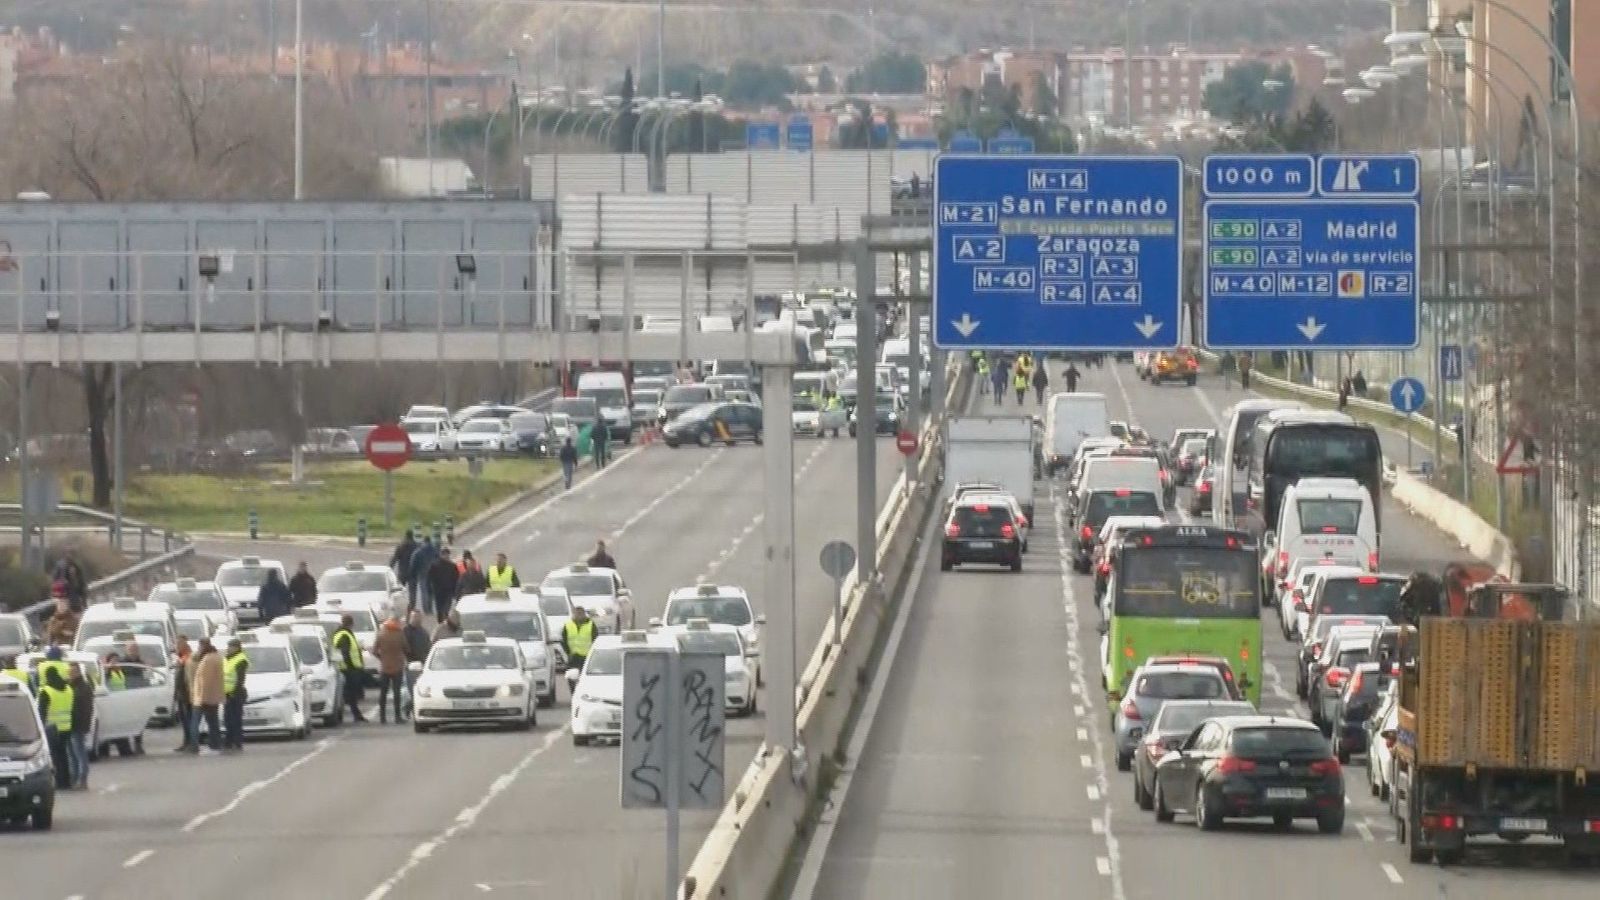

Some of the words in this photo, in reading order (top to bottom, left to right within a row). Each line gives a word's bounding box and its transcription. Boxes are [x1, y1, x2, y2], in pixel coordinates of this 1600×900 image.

[1031, 172, 1084, 189] M-14
[1215, 167, 1274, 185] 1000
[1285, 170, 1301, 184] m
[1393, 168, 1401, 185] 1
[1001, 195, 1046, 215] San
[1056, 195, 1168, 215] Fernando
[942, 206, 995, 222] M-21
[1212, 223, 1255, 237] E-90
[1265, 223, 1298, 237] A-2
[1326, 220, 1397, 240] Madrid
[957, 240, 1001, 258] A-2
[1037, 235, 1140, 256] Zaragoza
[1044, 257, 1080, 274] R-3
[1095, 257, 1135, 274] A-3
[1212, 250, 1255, 263] E-90
[1265, 250, 1298, 263] A-2
[1331, 250, 1349, 264] de
[1353, 250, 1413, 264] servicio
[976, 271, 1032, 287] M-40
[1213, 276, 1272, 292] M-40
[1281, 276, 1329, 292] M-12
[1374, 276, 1408, 292] R-2
[1043, 284, 1083, 301] R-4
[1097, 284, 1137, 301] A-4
